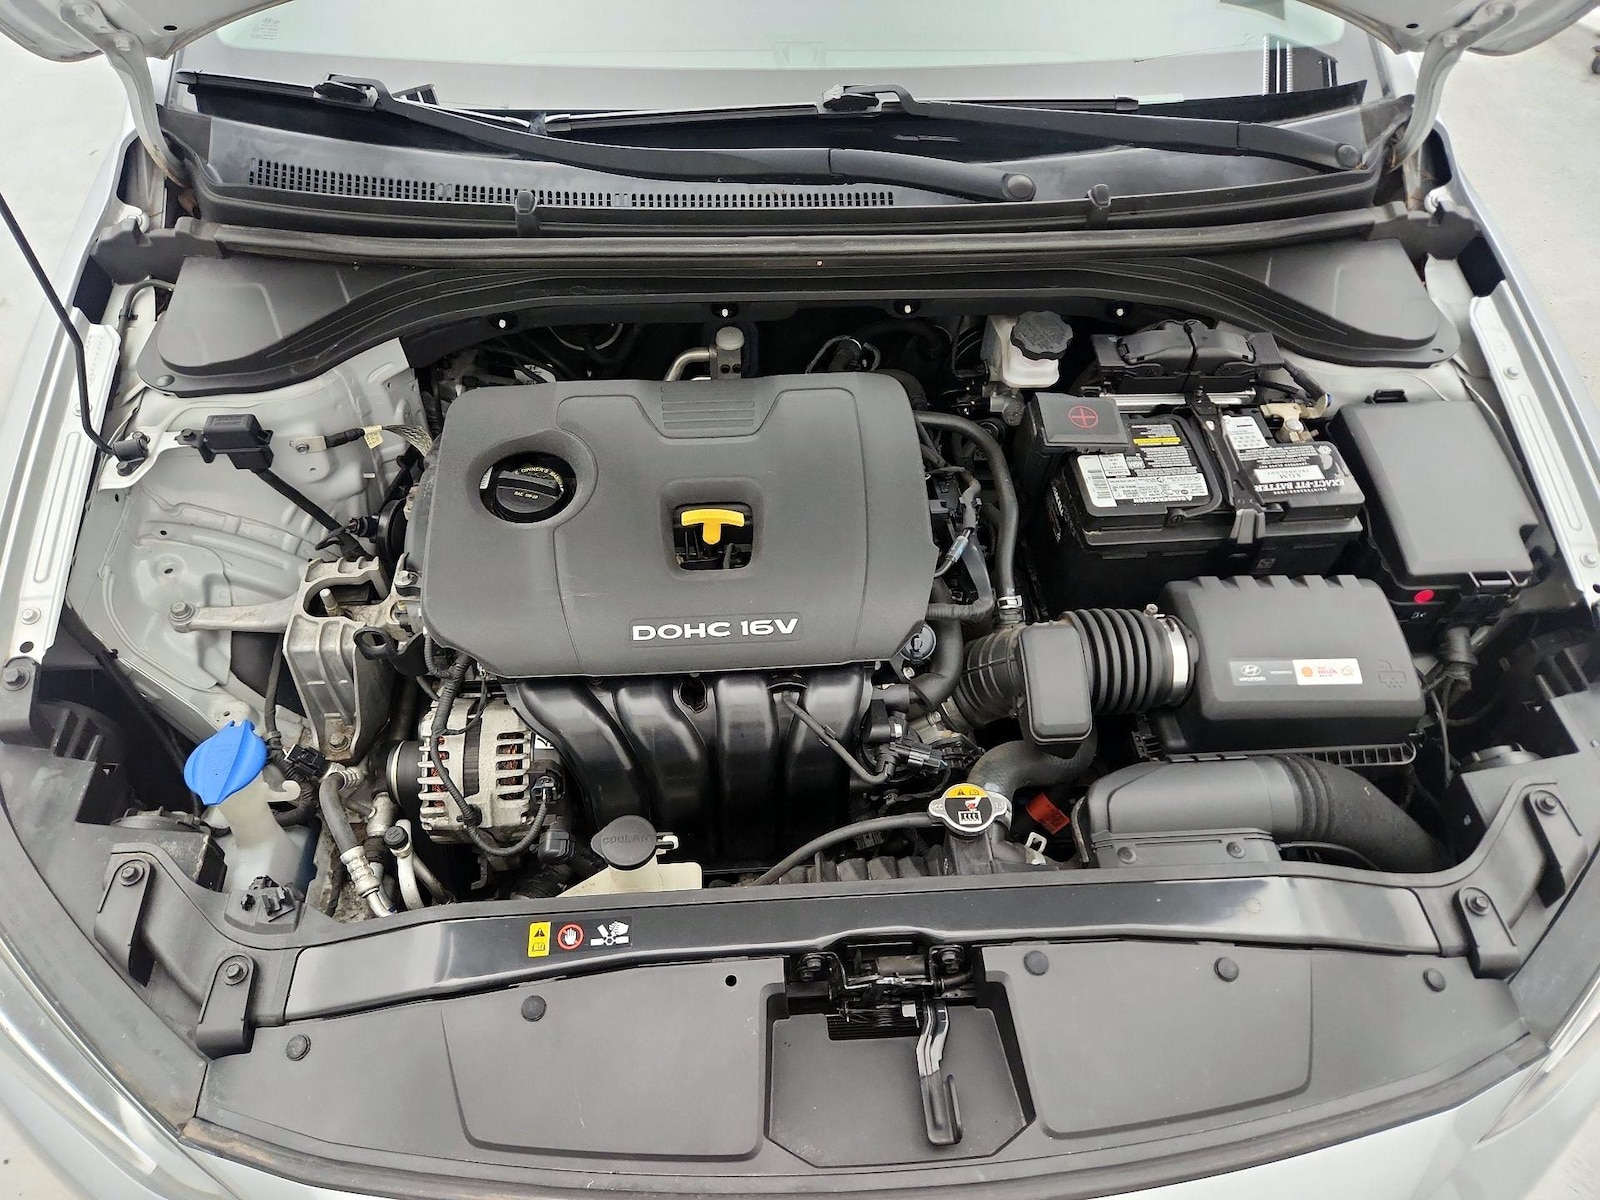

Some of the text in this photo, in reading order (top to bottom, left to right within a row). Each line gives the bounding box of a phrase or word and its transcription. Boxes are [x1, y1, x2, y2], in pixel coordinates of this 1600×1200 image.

[1254, 482, 1293, 492] BATTER
[632, 618, 799, 641] DOHC 16V
[602, 834, 654, 845] COOLANT
